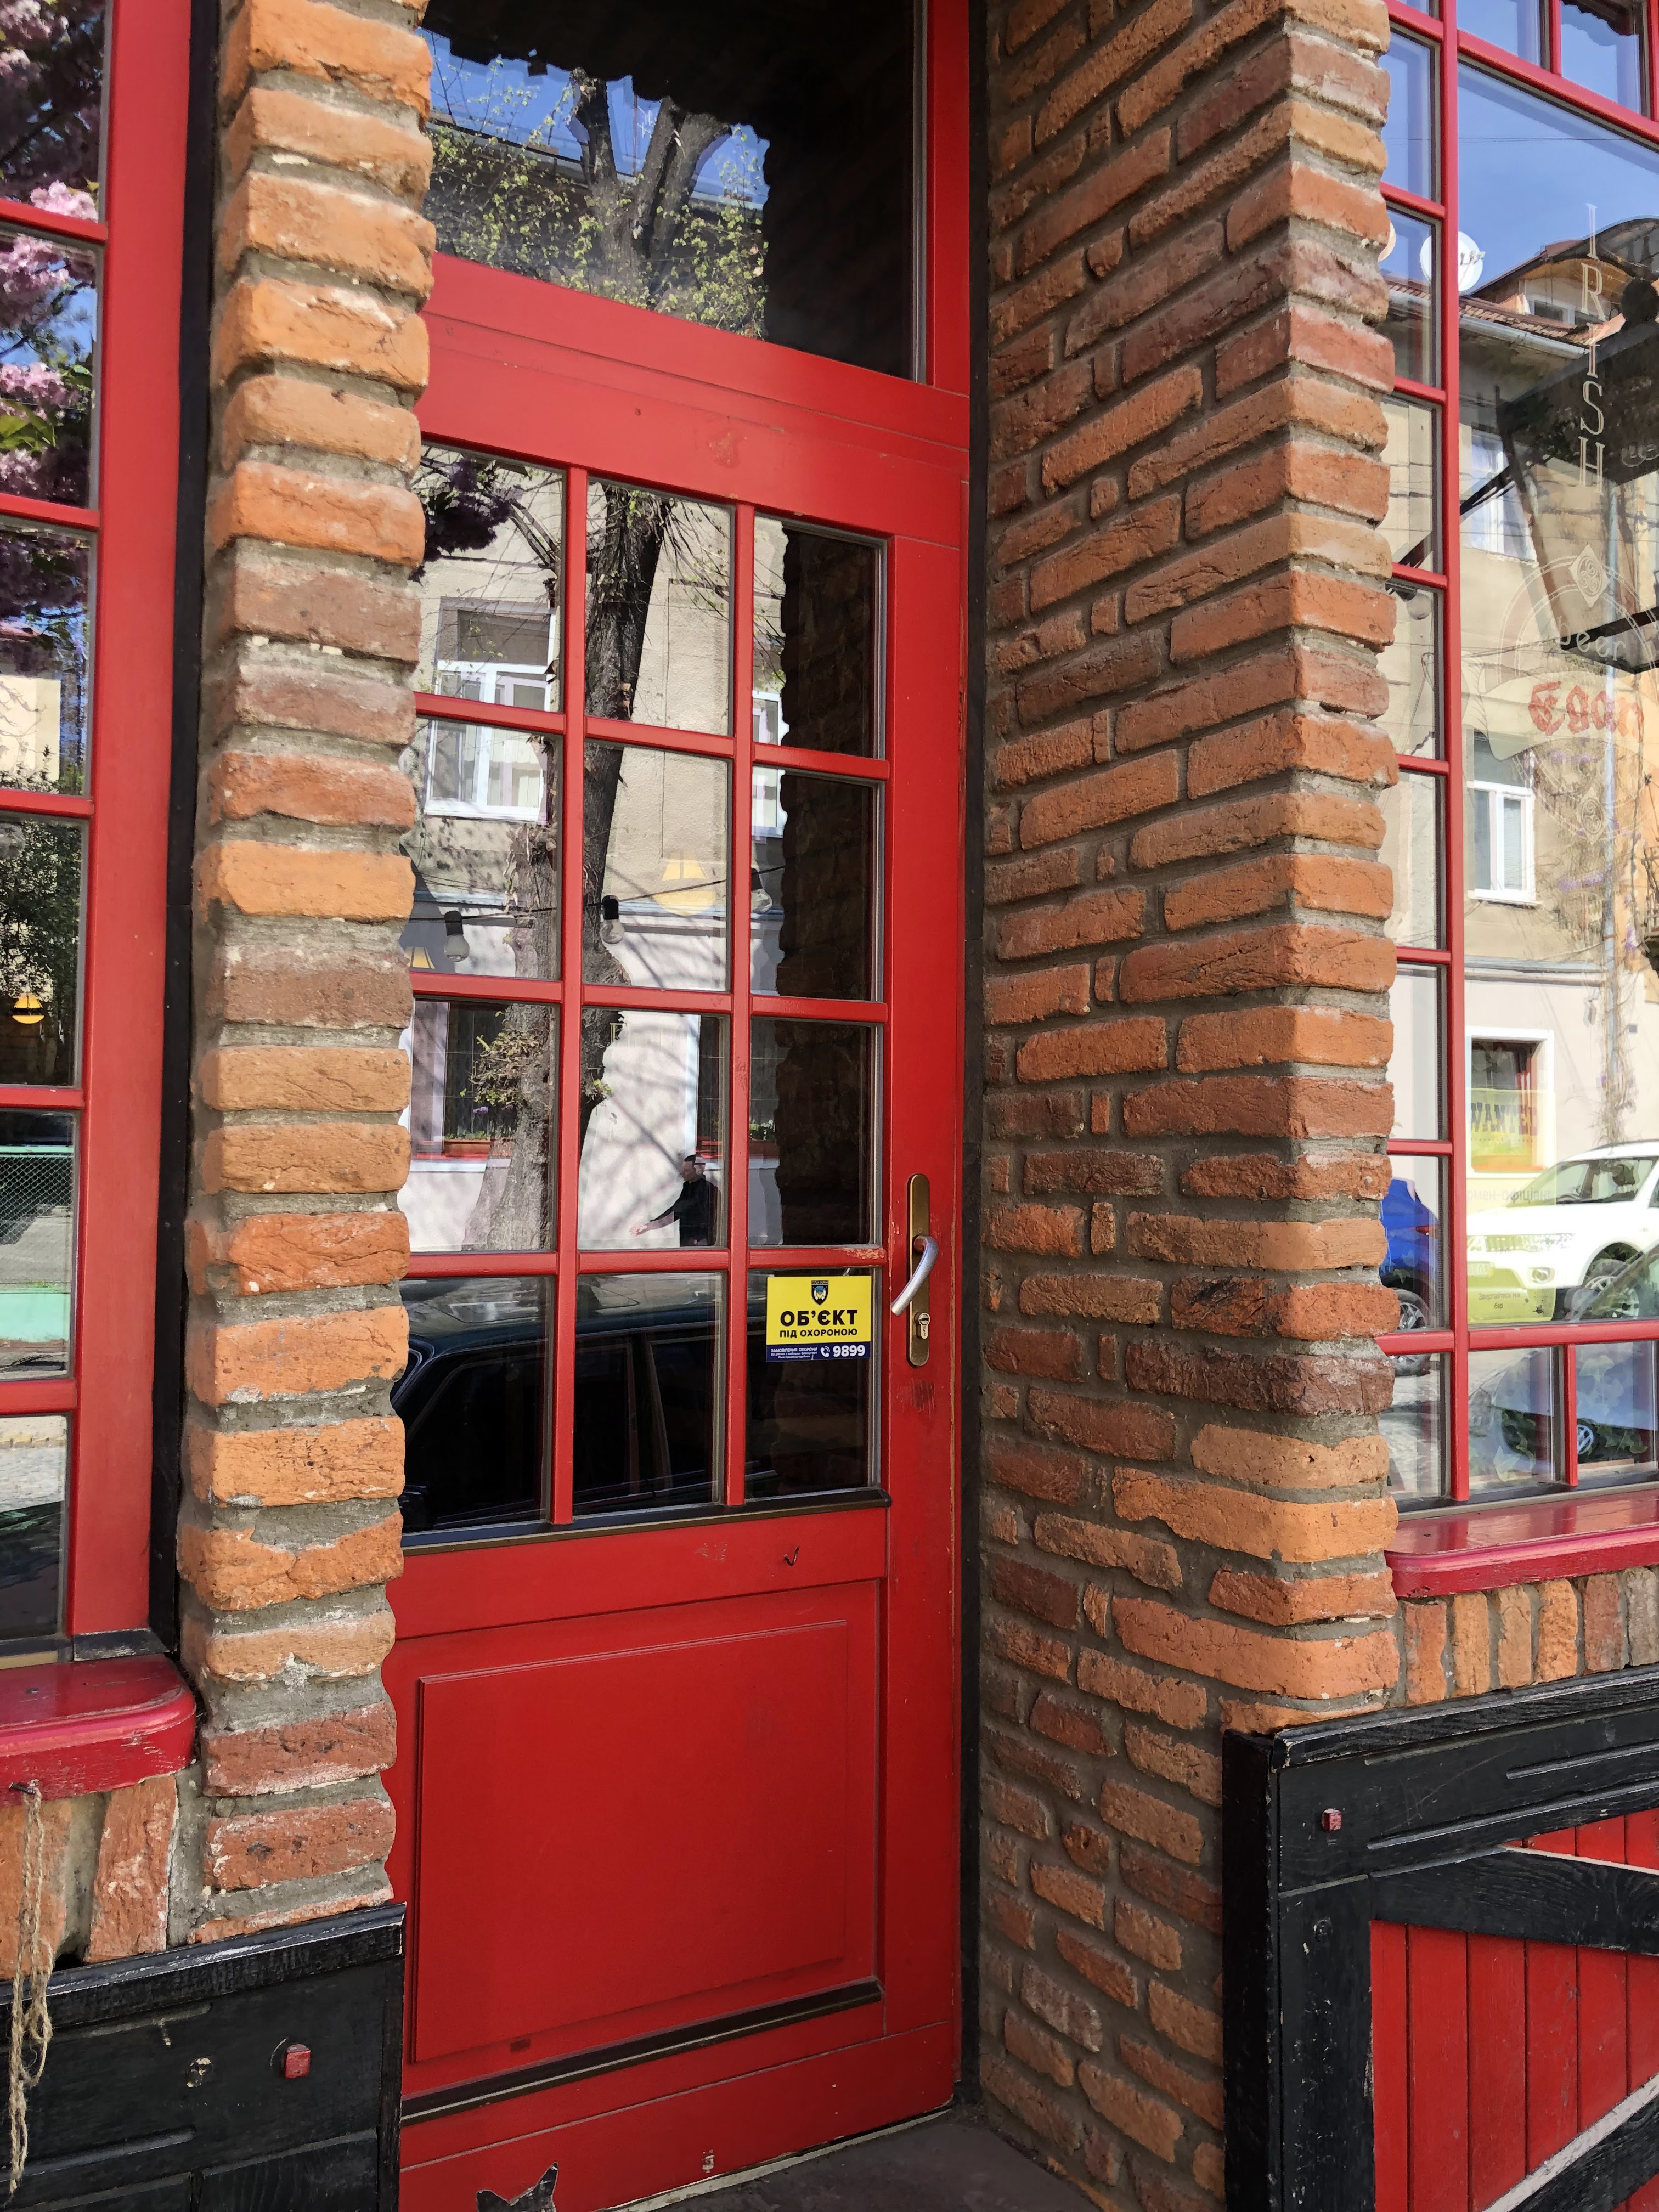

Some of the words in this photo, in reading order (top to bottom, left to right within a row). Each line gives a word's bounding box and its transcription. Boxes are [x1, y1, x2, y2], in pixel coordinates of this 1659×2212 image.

[1578, 202, 1605, 496] IRISH
[1557, 616, 1626, 661] beer
[1467, 1188, 1551, 1203] рмен-офіціант
[1479, 1292, 1511, 1300] Звертайтесь
[800, 1328, 857, 1336] ОХОРОНОЮ
[833, 1345, 866, 1357] 9899
